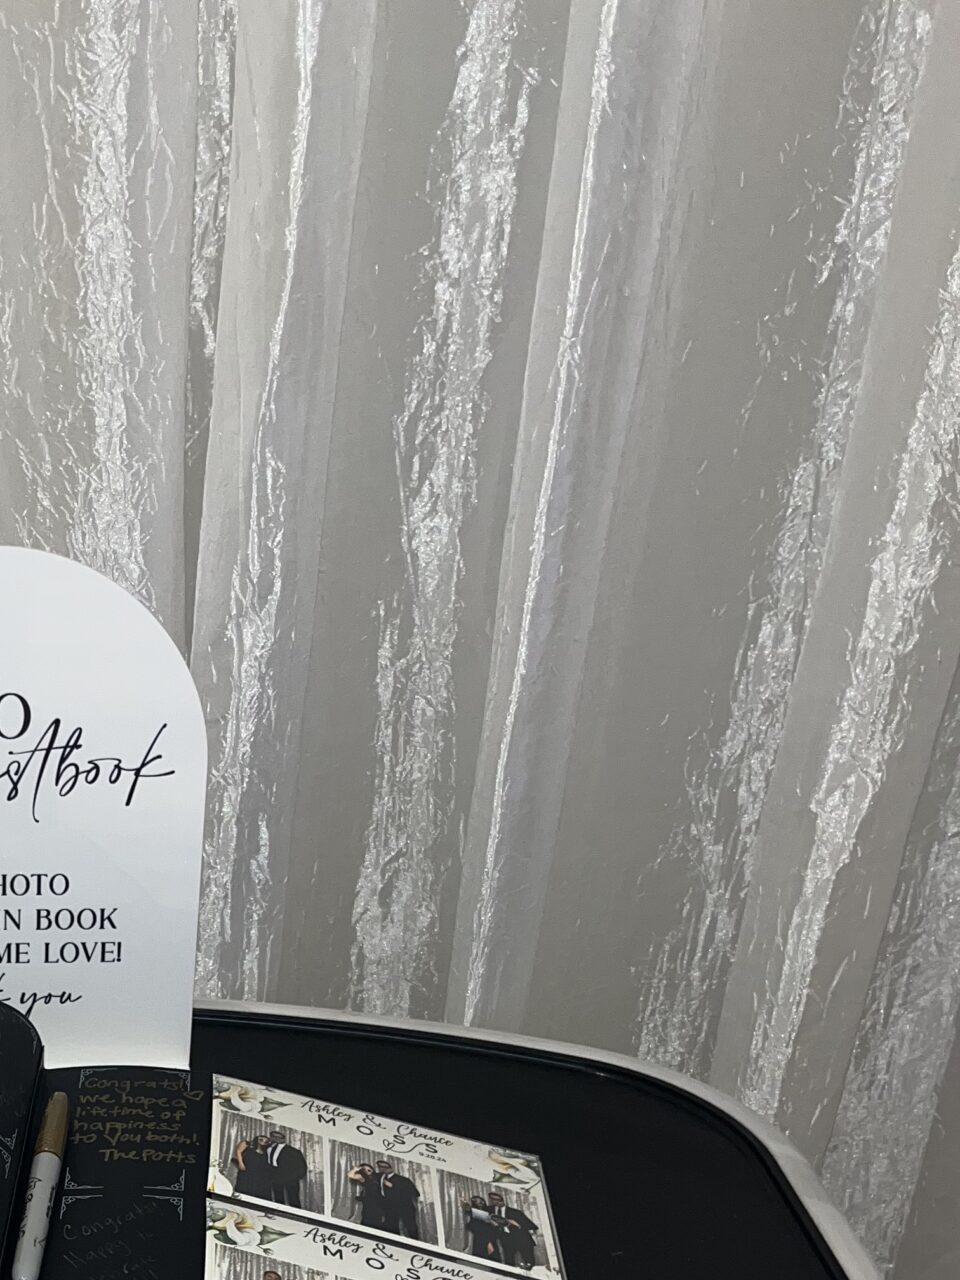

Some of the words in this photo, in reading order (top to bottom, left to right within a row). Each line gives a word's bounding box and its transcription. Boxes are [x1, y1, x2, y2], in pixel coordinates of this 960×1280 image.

[35, 907, 119, 931] BOOK
[43, 941, 122, 963] LOVE!
[20, 991, 82, 1019] you
[84, 1077, 185, 1094] Congrats!
[121, 1092, 170, 1110] hope
[171, 1098, 188, 1109] a
[160, 1110, 187, 1122] of
[301, 1100, 355, 1121] Ashley
[362, 1114, 387, 1130] &
[397, 1124, 454, 1147] Chance
[73, 1120, 182, 1135] happiness
[70, 1132, 97, 1145] to
[98, 1148, 140, 1163] The
[142, 1149, 197, 1164] Potts
[304, 1227, 363, 1254] Ashley
[373, 1243, 399, 1262] &
[410, 1254, 474, 1280] Chance
